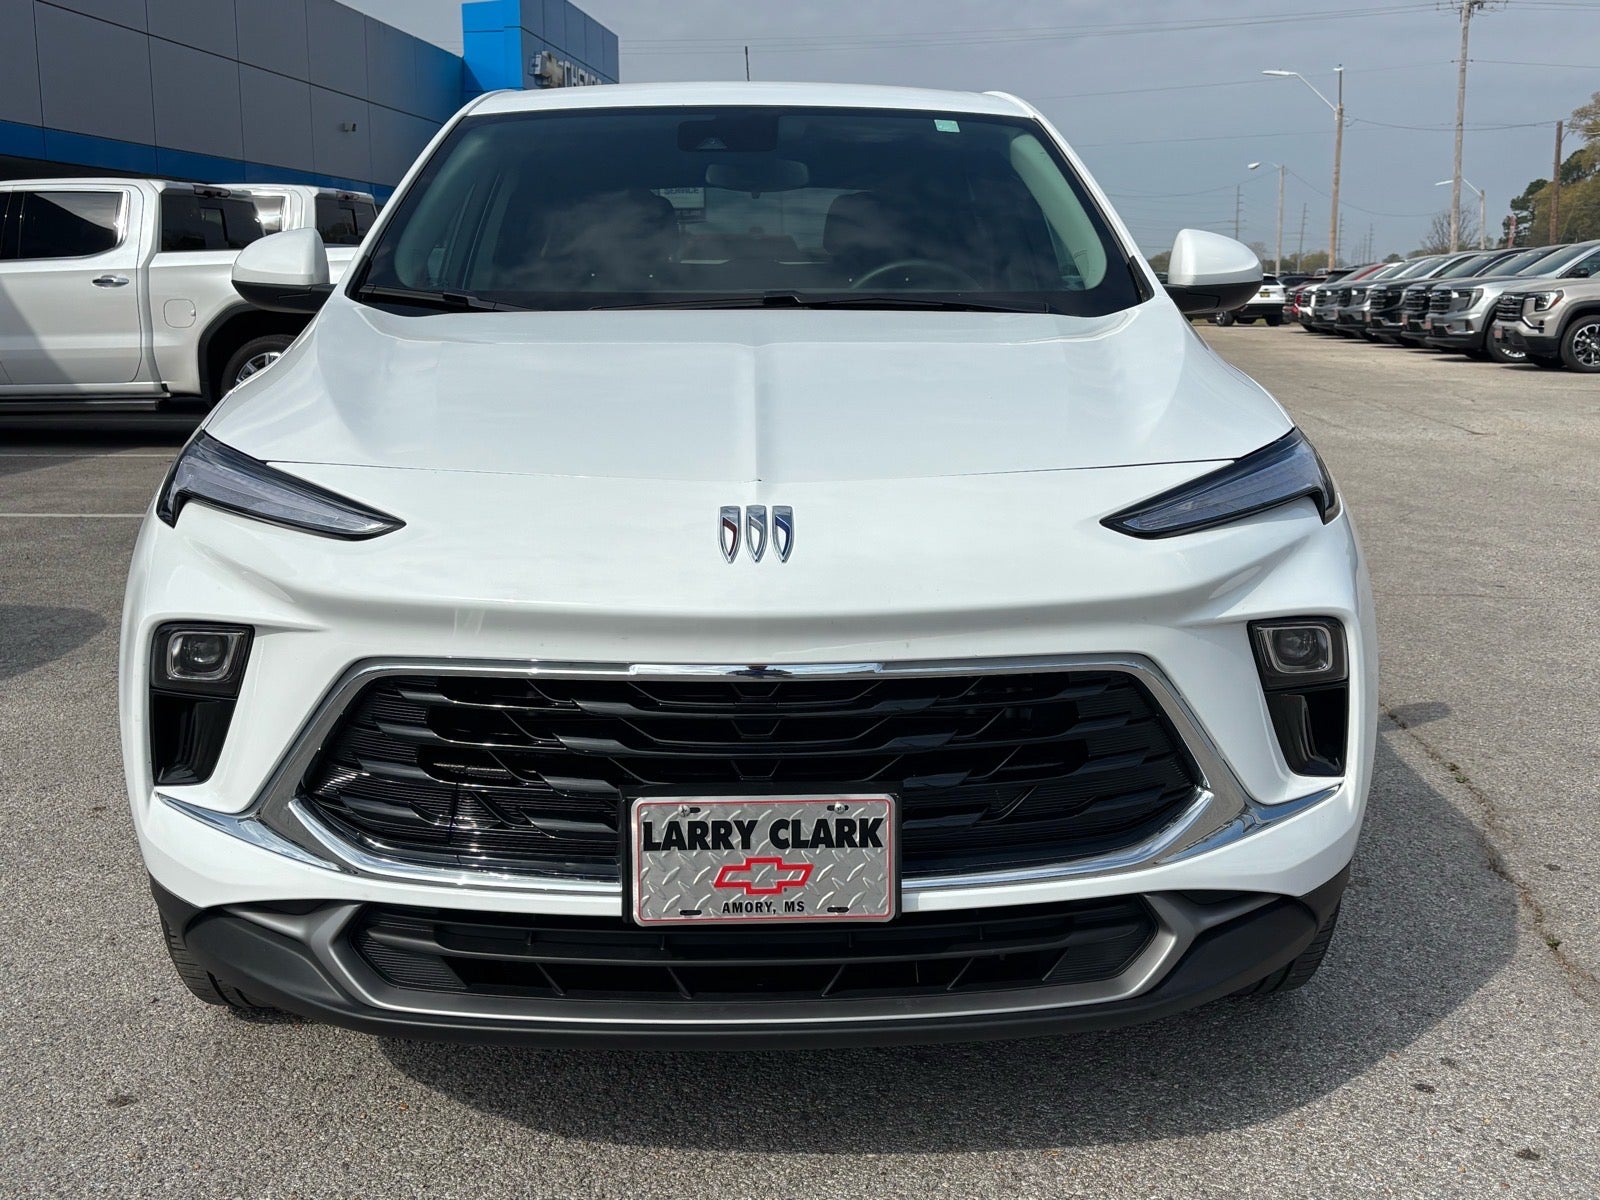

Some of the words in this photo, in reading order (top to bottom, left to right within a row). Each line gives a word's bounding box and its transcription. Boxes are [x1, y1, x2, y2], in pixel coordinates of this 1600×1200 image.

[642, 820, 758, 851] LARRY
[769, 818, 884, 850] CLARK
[722, 901, 776, 914] AMORY,
[784, 900, 805, 913] MS
